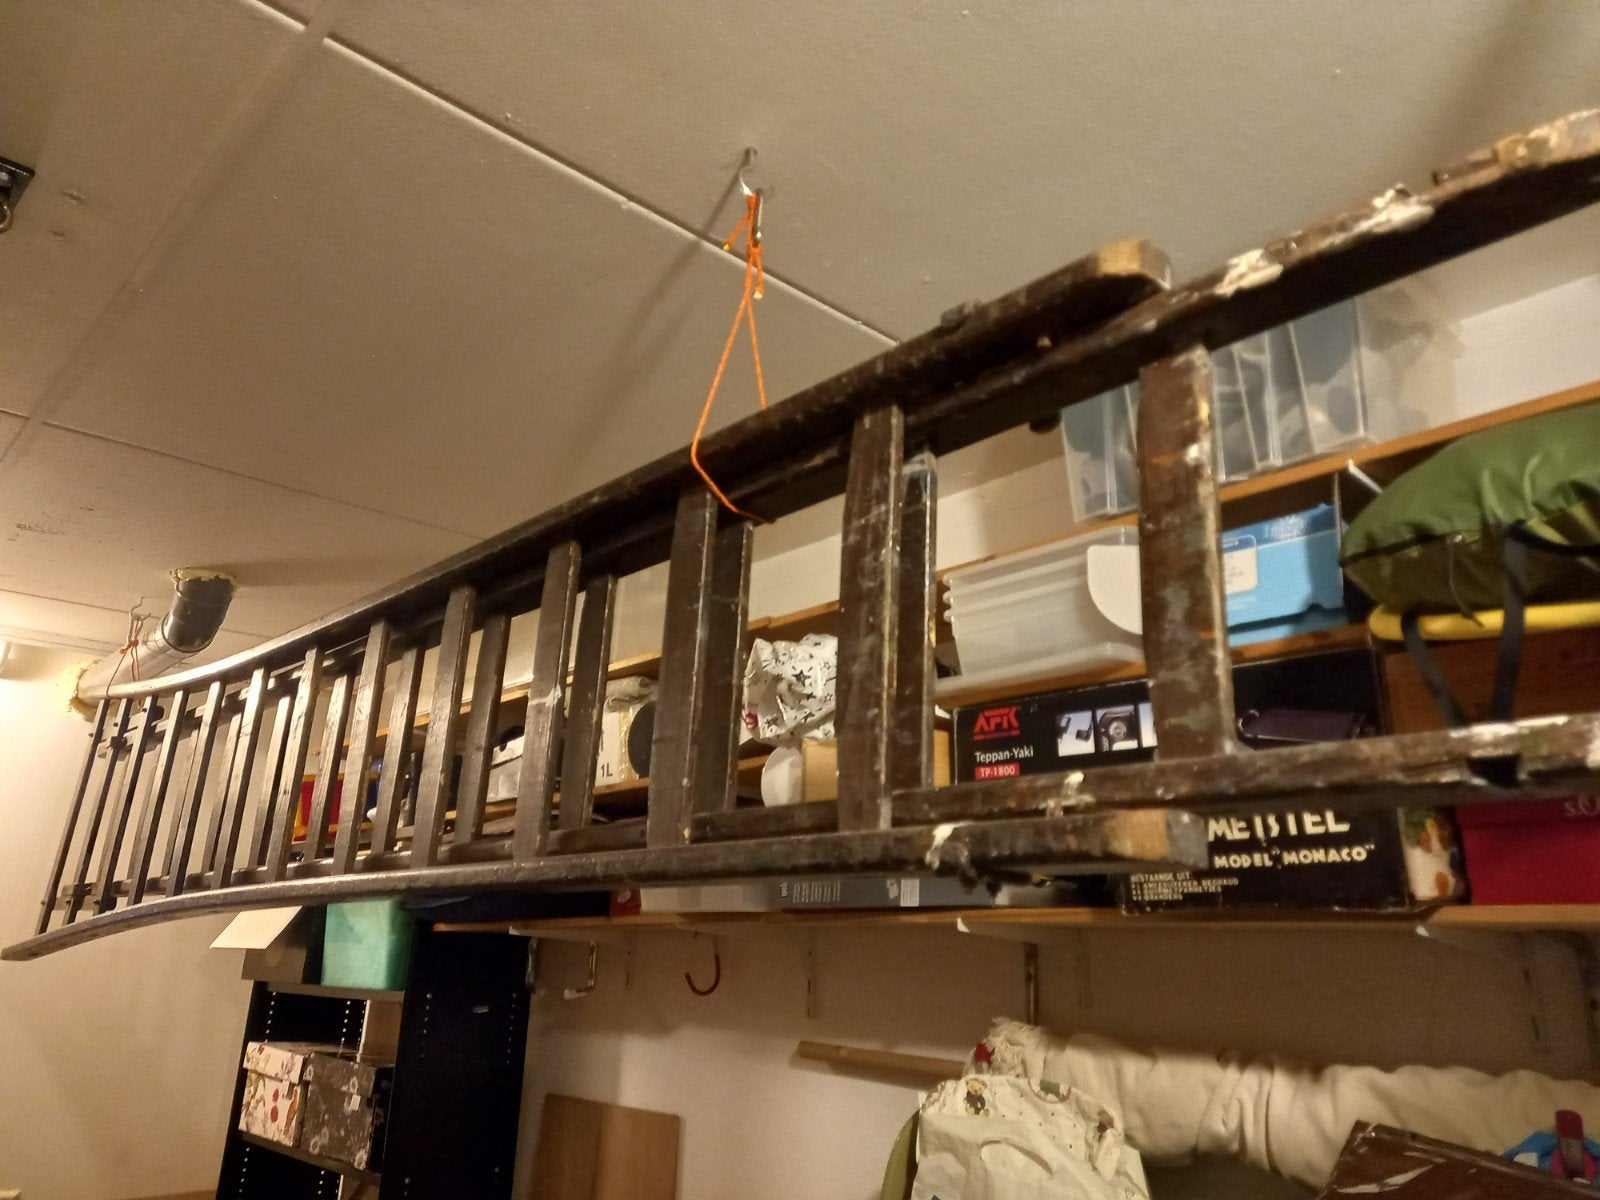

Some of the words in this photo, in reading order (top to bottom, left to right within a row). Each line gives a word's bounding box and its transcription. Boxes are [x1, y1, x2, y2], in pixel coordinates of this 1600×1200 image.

[975, 746, 1034, 764] Teppan-Yaki
[600, 762, 613, 778] 1L
[980, 765, 1015, 778] TP-1800
[1213, 852, 1273, 869] MODEL
